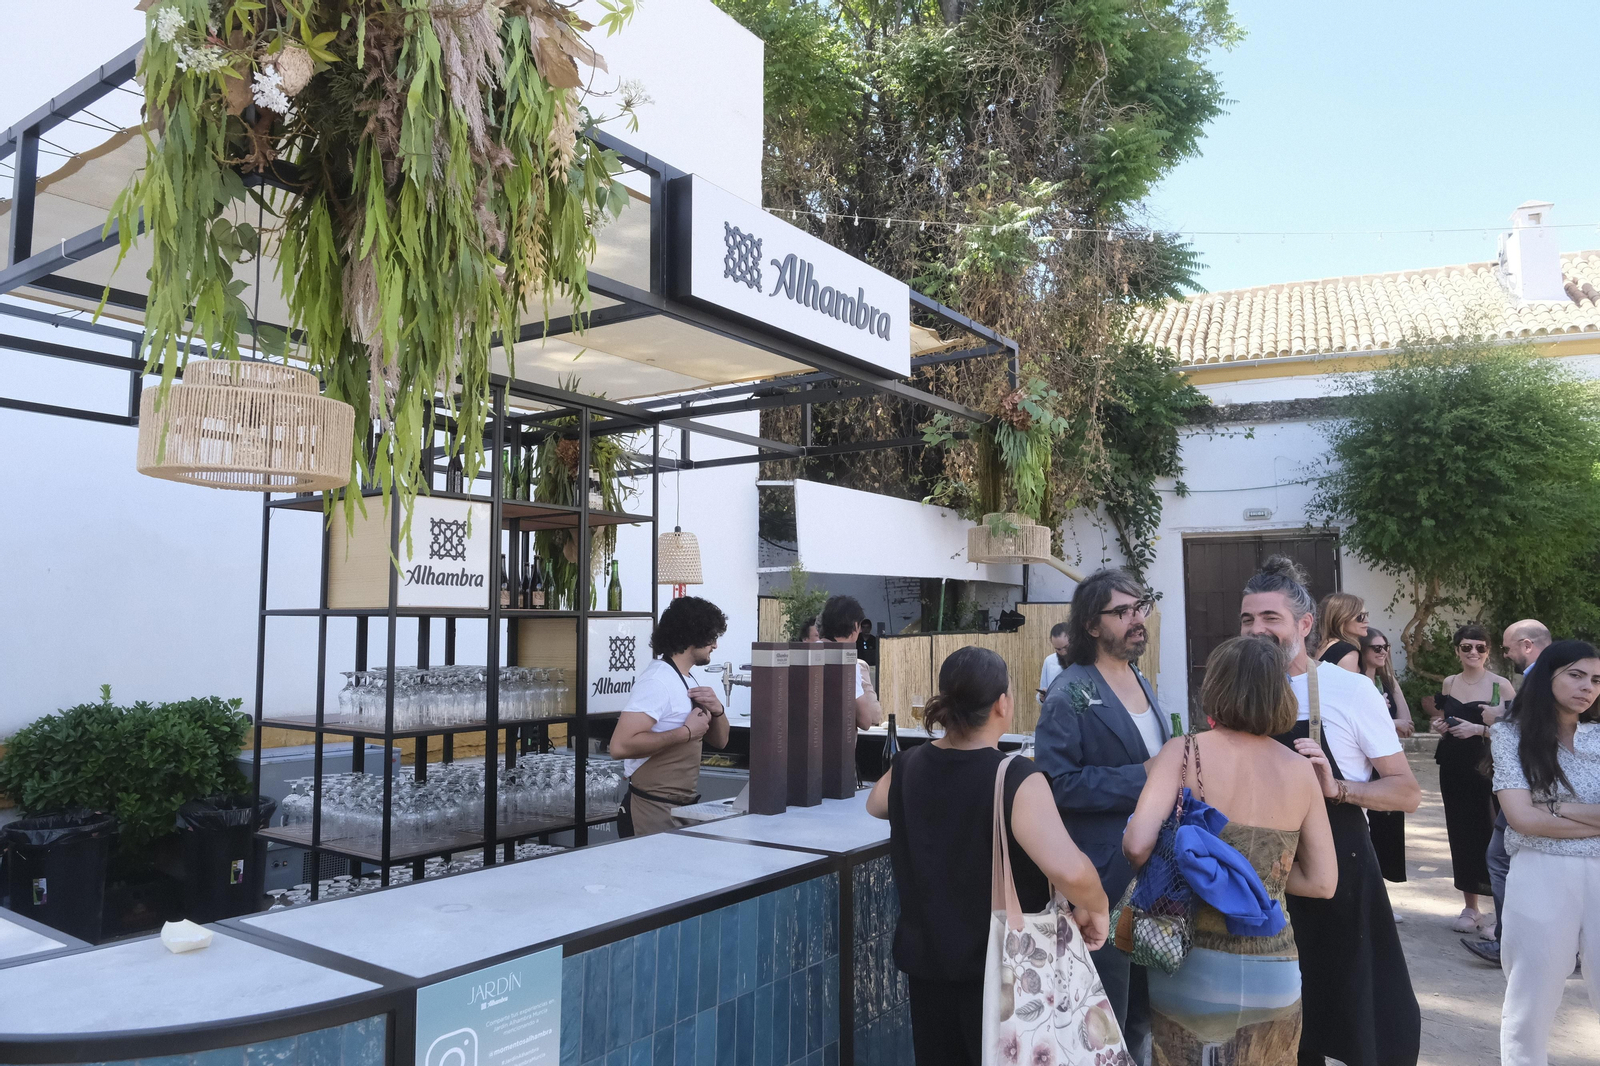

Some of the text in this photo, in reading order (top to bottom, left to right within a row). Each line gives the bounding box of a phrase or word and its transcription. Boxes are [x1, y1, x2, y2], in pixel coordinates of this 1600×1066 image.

[769, 253, 891, 341] Alhambra
[404, 564, 484, 588] Alhambra
[467, 971, 522, 1005] JARDÍN
